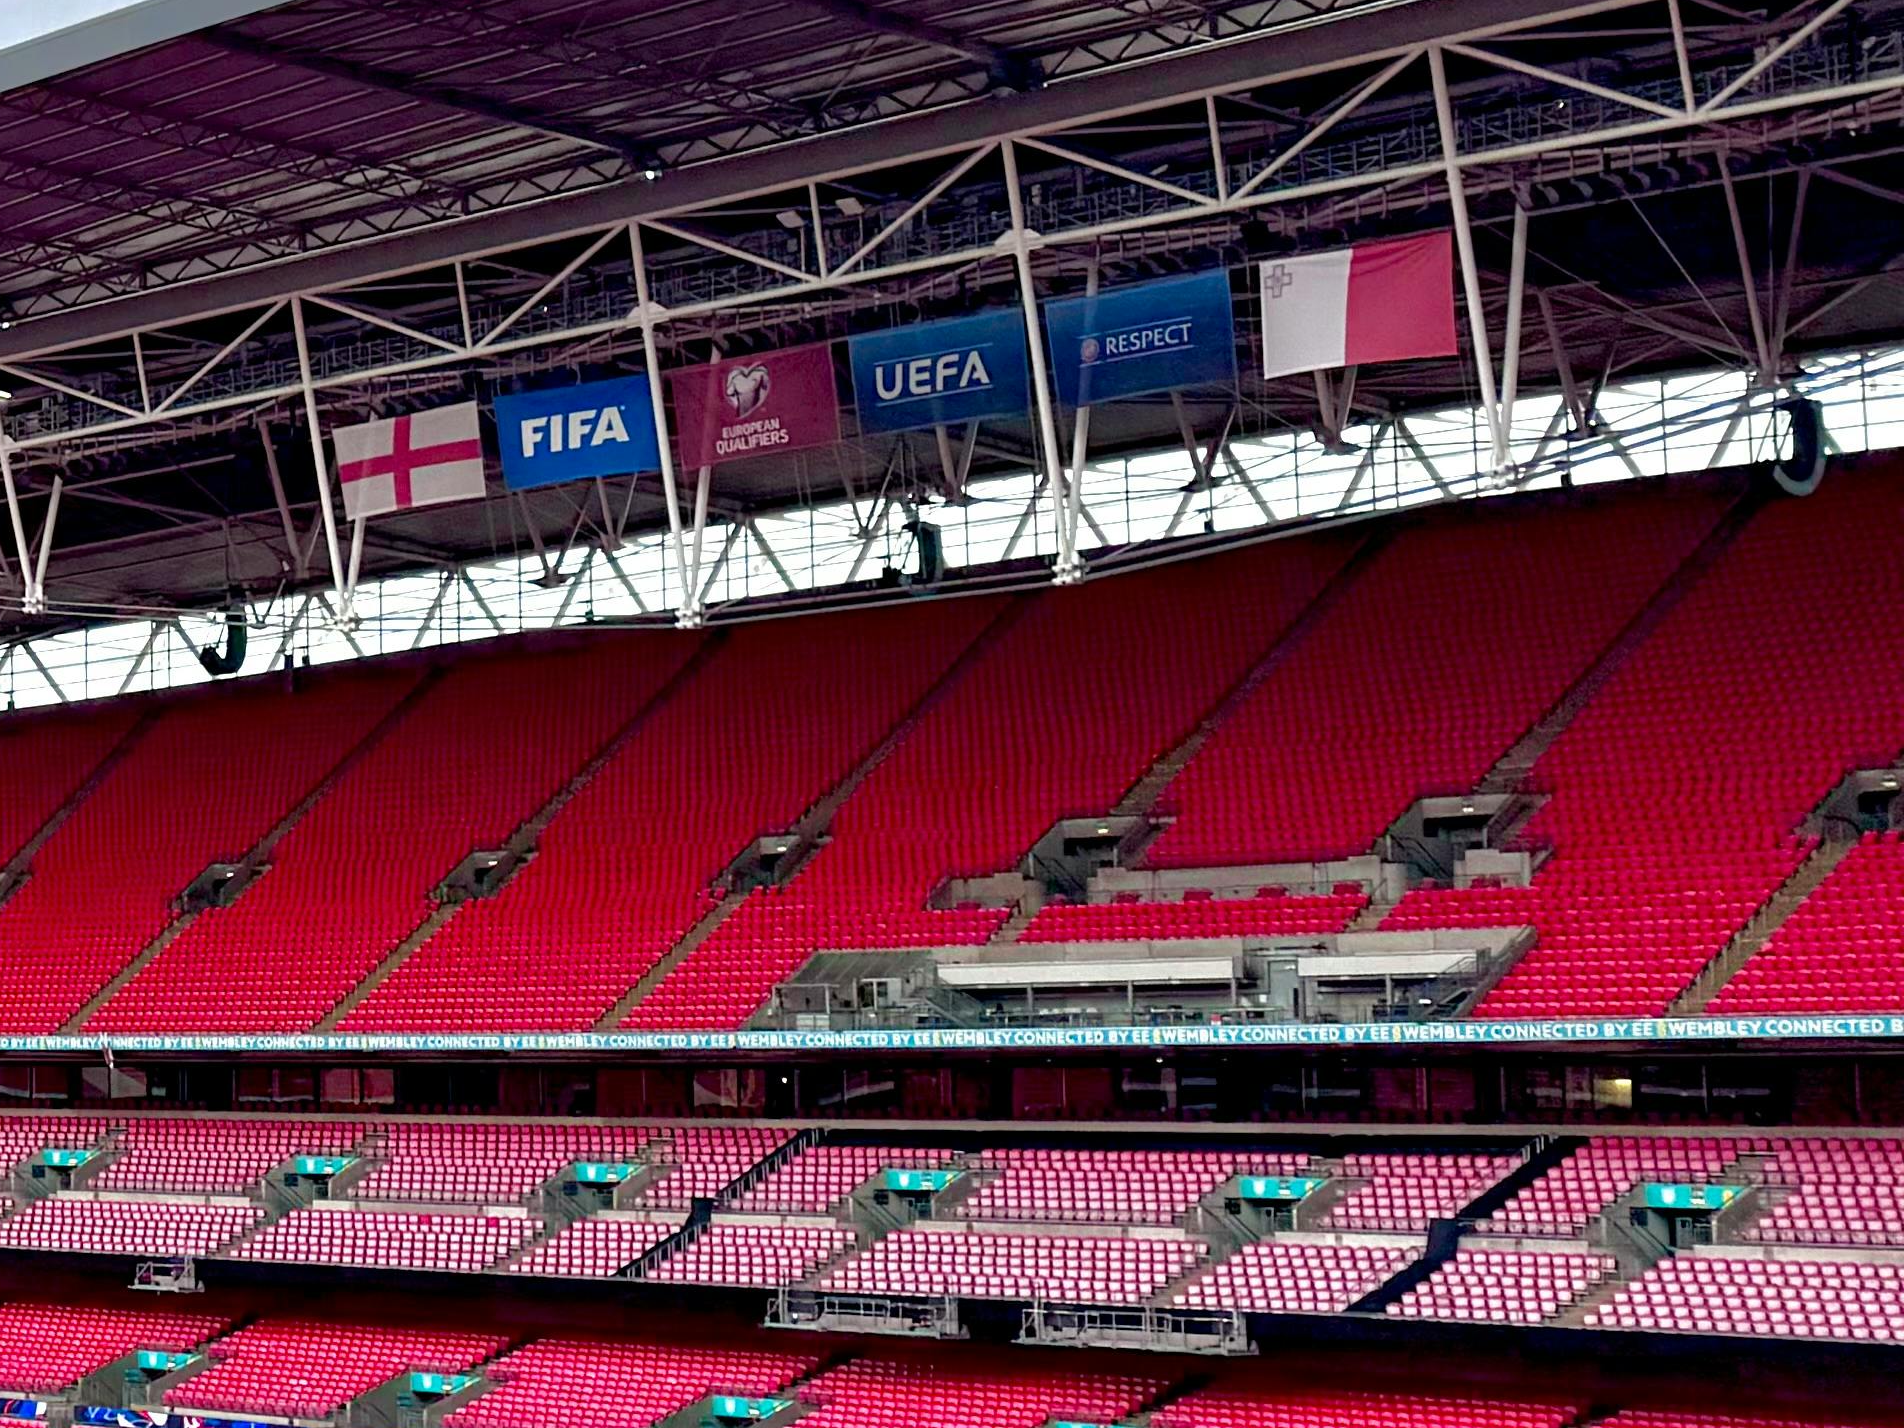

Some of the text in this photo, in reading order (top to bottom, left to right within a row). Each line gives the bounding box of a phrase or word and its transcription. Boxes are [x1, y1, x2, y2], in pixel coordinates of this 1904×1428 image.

[1106, 323, 1192, 355] RESPECT
[875, 350, 990, 400] UEFA
[521, 406, 629, 458] FIFA
[716, 429, 789, 455] QUALIFIERS
[722, 418, 780, 439] EUROPEAN
[202, 1036, 255, 1049] WEMBLEY
[257, 1036, 324, 1049] CONNECTED
[369, 1036, 424, 1048] WEMBLEY
[428, 1036, 498, 1048] CONNECTED
[504, 1036, 521, 1048] BY
[523, 1036, 536, 1048] EE
[546, 1036, 606, 1048] WEMBLEY
[610, 1035, 686, 1047] CONNECTED
[691, 1035, 708, 1047] BY
[710, 1035, 726, 1047] EE
[739, 1035, 803, 1047] WEMBLEY
[806, 1034, 888, 1047] CONNECTED
[894, 1034, 911, 1046] BY
[915, 1033, 930, 1045] EE
[943, 1033, 1010, 1045] WEMBLEY
[1014, 1031, 1103, 1044] CONNECTED
[1109, 1031, 1130, 1043] BY
[1133, 1031, 1149, 1043] EE
[1163, 1030, 1237, 1043] WEMBLEY
[1241, 1028, 1338, 1042] CONNECTED
[1345, 1028, 1364, 1040] BY
[1370, 1027, 1388, 1039] EE
[1402, 1026, 1488, 1040] WEMBLEY
[1492, 1023, 1598, 1039] CONNECTED
[1604, 1023, 1627, 1037] BY
[1632, 1022, 1652, 1036] EE
[1668, 1021, 1761, 1037] WEMBLEY
[1765, 1019, 1884, 1035] CONNECTED
